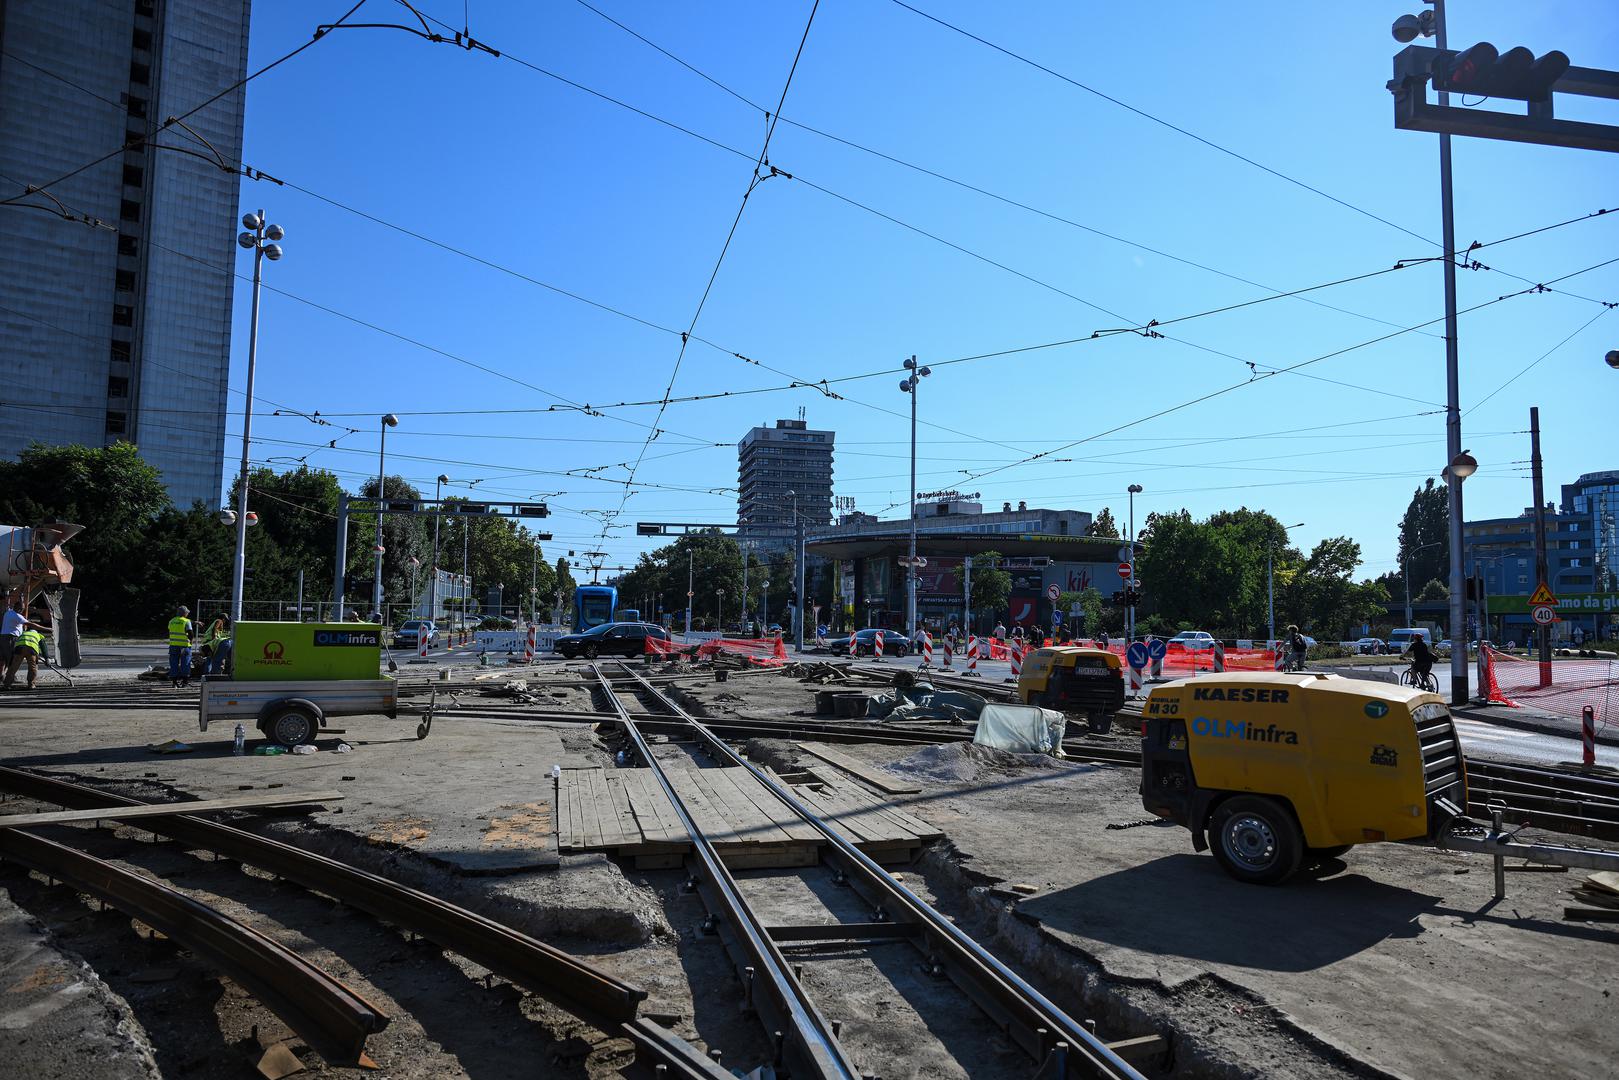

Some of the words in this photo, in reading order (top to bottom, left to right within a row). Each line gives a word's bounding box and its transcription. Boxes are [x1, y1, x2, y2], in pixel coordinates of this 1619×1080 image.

[1583, 595, 1600, 608] da
[1537, 610, 1551, 620] 40
[316, 631, 377, 645] OLMinfra
[1194, 687, 1290, 704] KAESER
[1149, 703, 1160, 714] M
[1161, 703, 1179, 715] 30
[1191, 716, 1299, 745] OLMinfra
